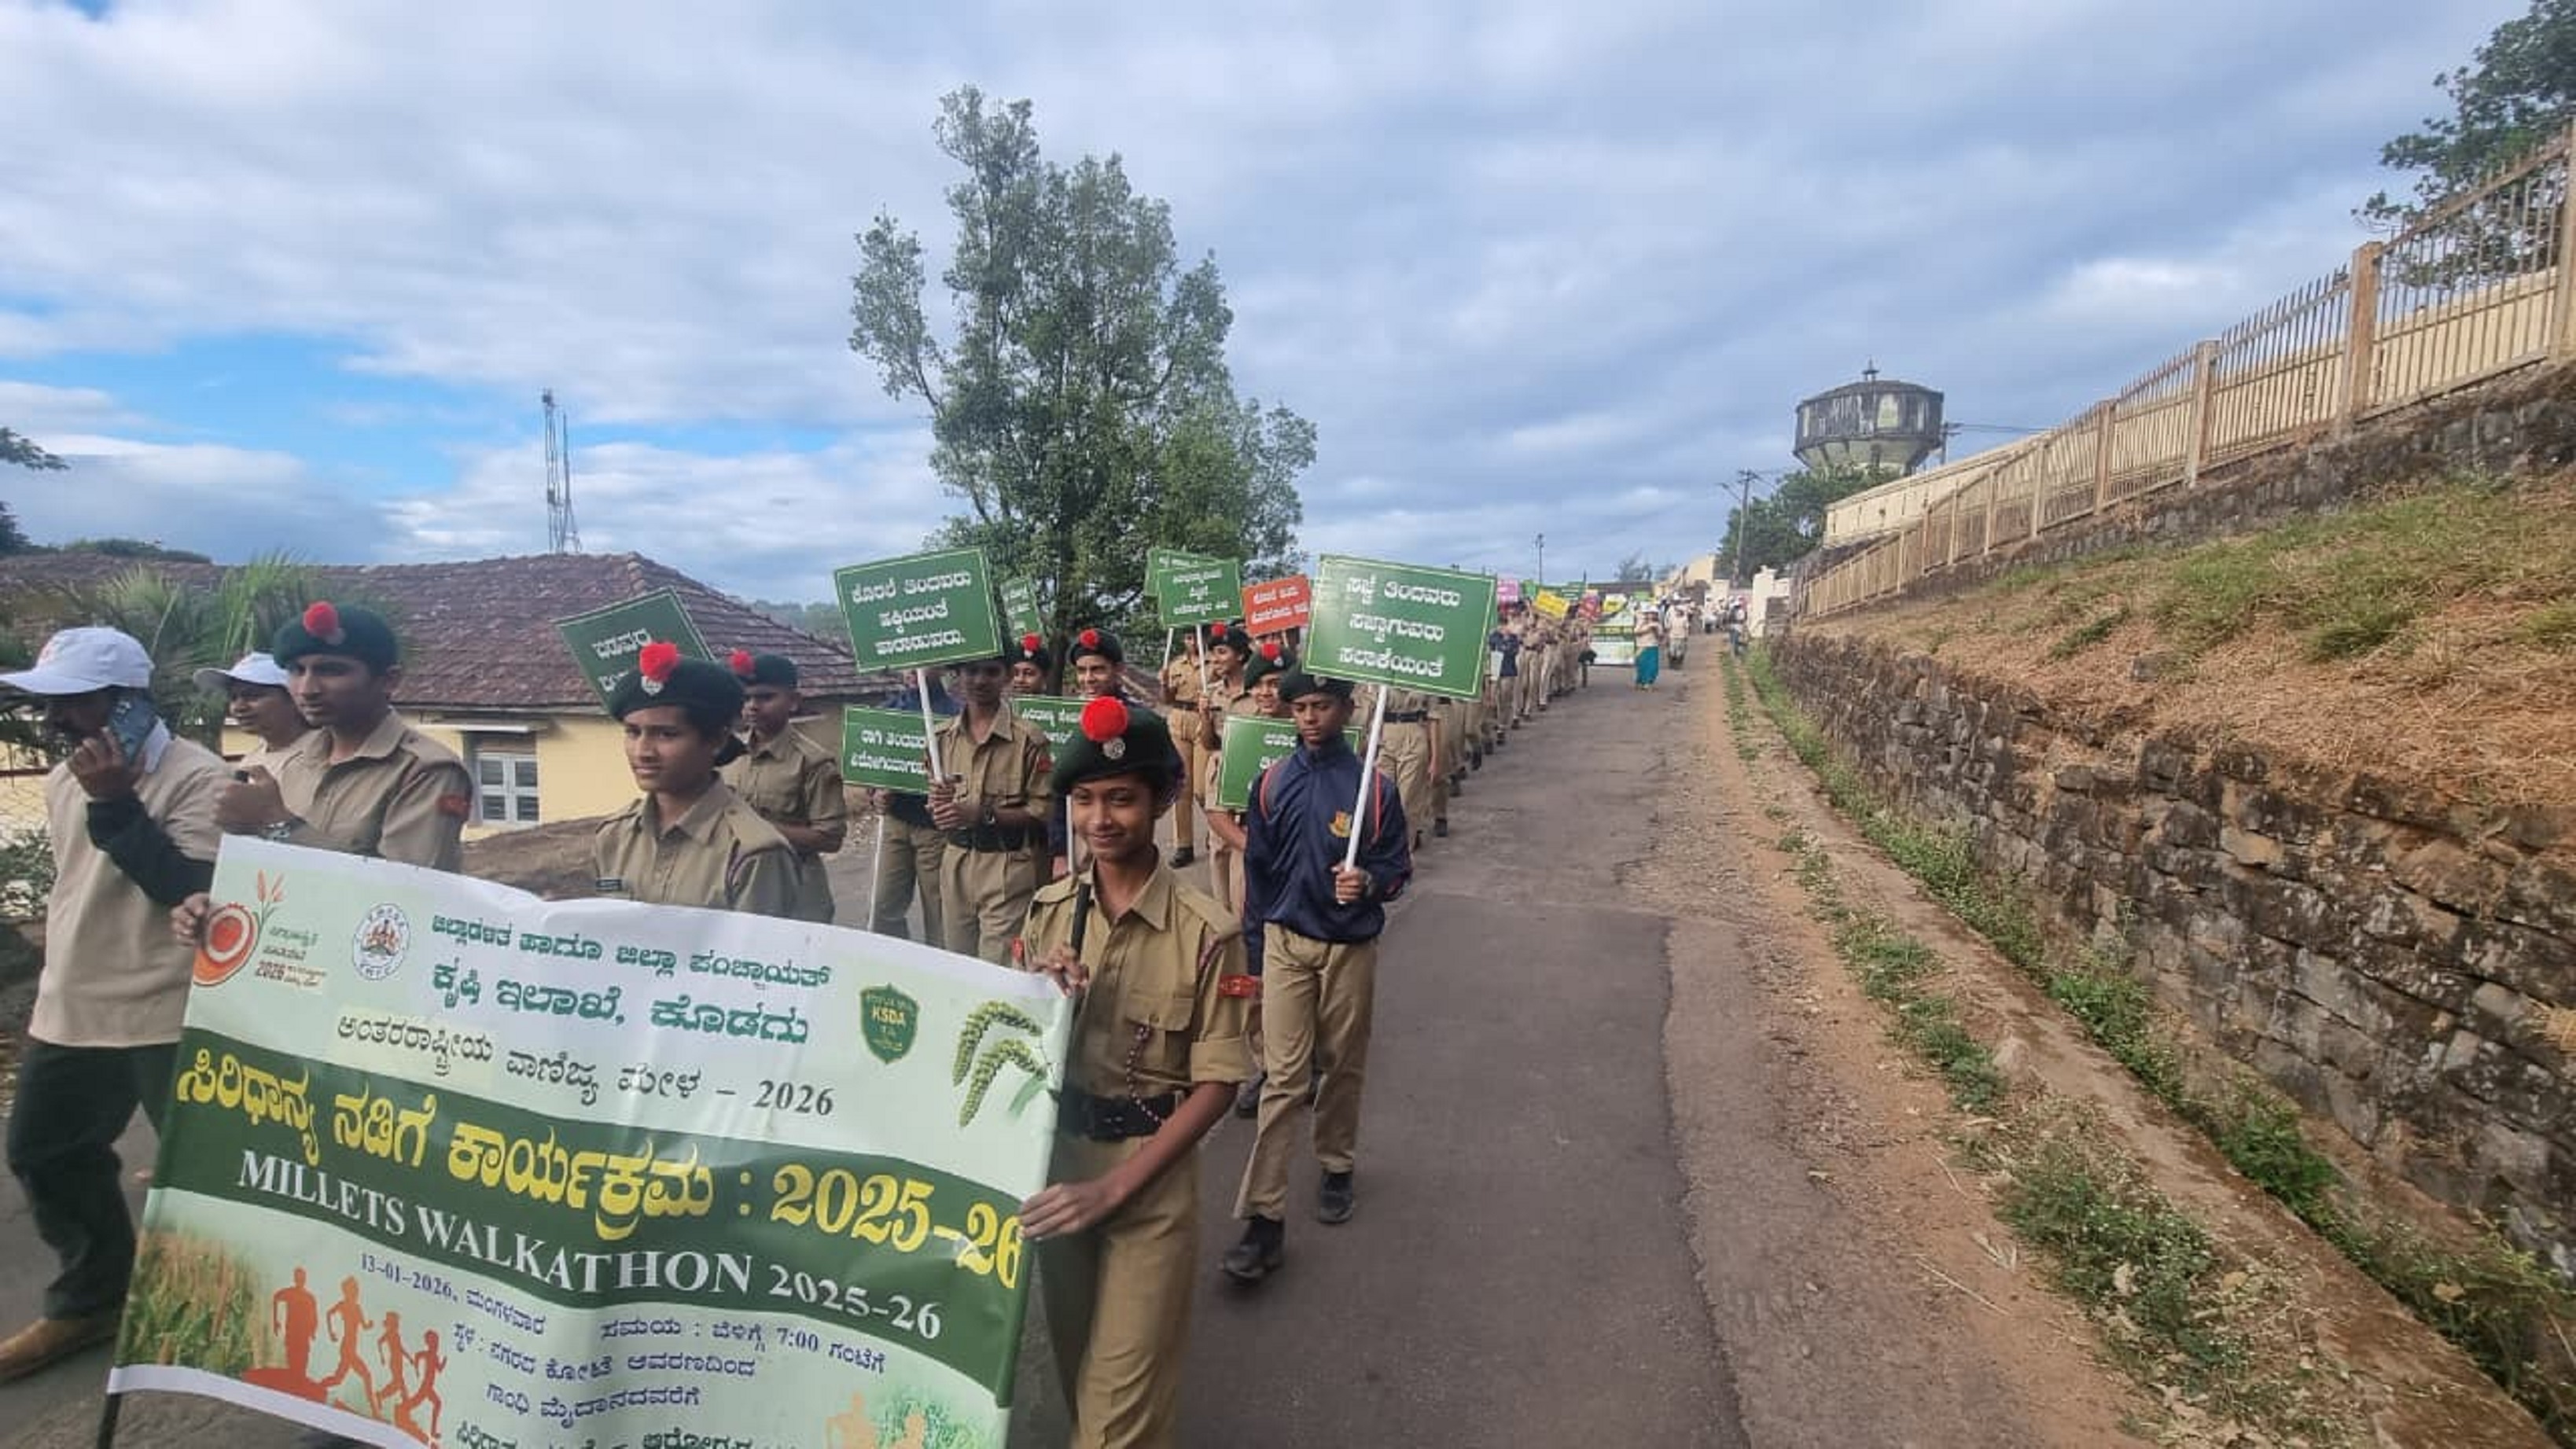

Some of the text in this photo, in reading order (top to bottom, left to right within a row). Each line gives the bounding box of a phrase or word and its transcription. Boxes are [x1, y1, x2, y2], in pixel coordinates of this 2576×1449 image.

[903, 571, 972, 594] ತಿಂದವರು
[1384, 580, 1461, 607] ತಿಂದವರು
[520, 931, 602, 962] ಹಾಗೂ
[616, 943, 677, 977] ಜಿಲ್ಲಾ
[432, 956, 809, 1043] ಕೃಷಿ ಇಲಾಖೆ, ಕೊಡಗು
[871, 1006, 906, 1028] KSDA
[506, 1049, 599, 1106] ವಾಣಿಜ್ಯ
[617, 1063, 701, 1098] ಮೇಳ
[753, 1079, 835, 1116] 2026
[176, 1047, 319, 1166] ಸಿರಿಧಾನ್ಯ
[333, 1078, 437, 1168] ನಡಿಗೆ
[447, 1120, 714, 1241] ಕಾರ್ಯಕ್ರಮ
[739, 1171, 752, 1216] :
[237, 1149, 942, 1340] MILLETS WALKATHON 2025-26
[466, 1288, 546, 1336] ಮಂಗಳವಾರ
[600, 1317, 682, 1340] ಸಮಯ
[776, 1326, 819, 1352] 7:00
[546, 1355, 613, 1382] ಕೋಟೆ
[627, 1351, 756, 1377] ಆವರಣದಿಂದ
[540, 1386, 701, 1429] ಮೈದಾನದವರೆಗೆ
